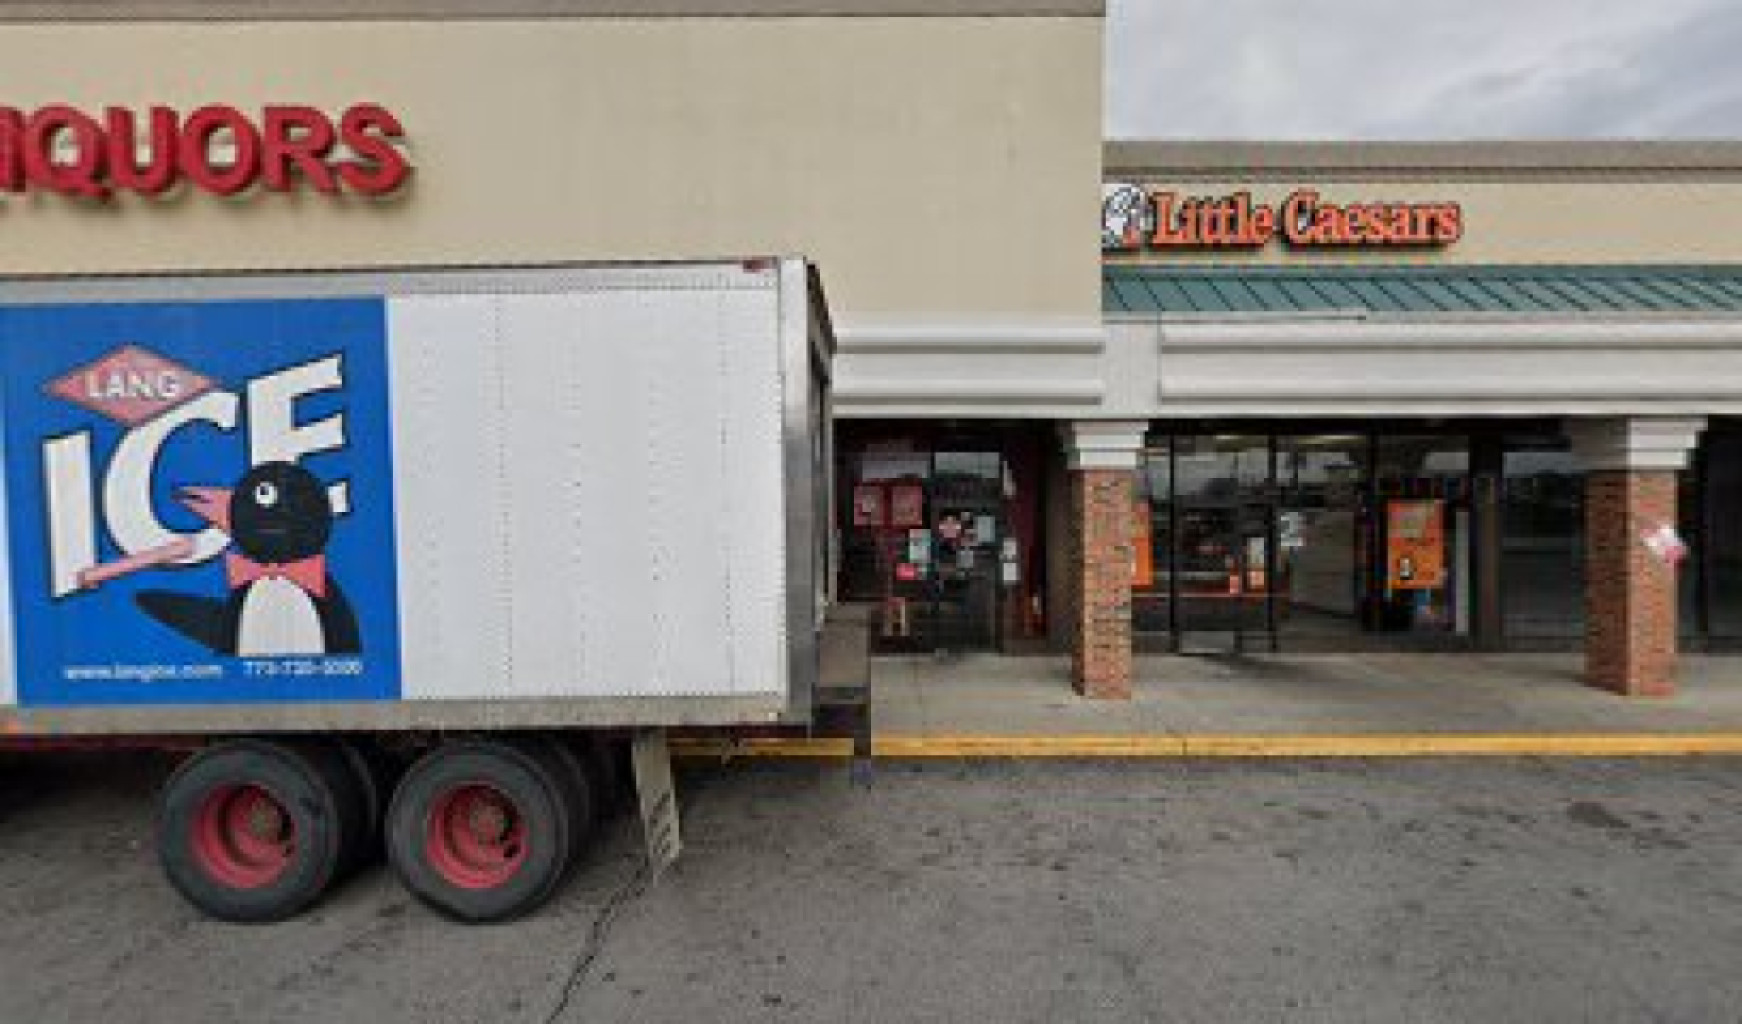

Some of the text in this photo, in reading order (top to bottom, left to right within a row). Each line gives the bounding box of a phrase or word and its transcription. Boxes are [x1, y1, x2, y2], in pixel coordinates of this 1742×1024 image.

[0, 102, 410, 199] IQUORS
[1151, 187, 1462, 245] Little Caesars
[86, 371, 179, 398] LANG
[42, 354, 347, 598] ICE
